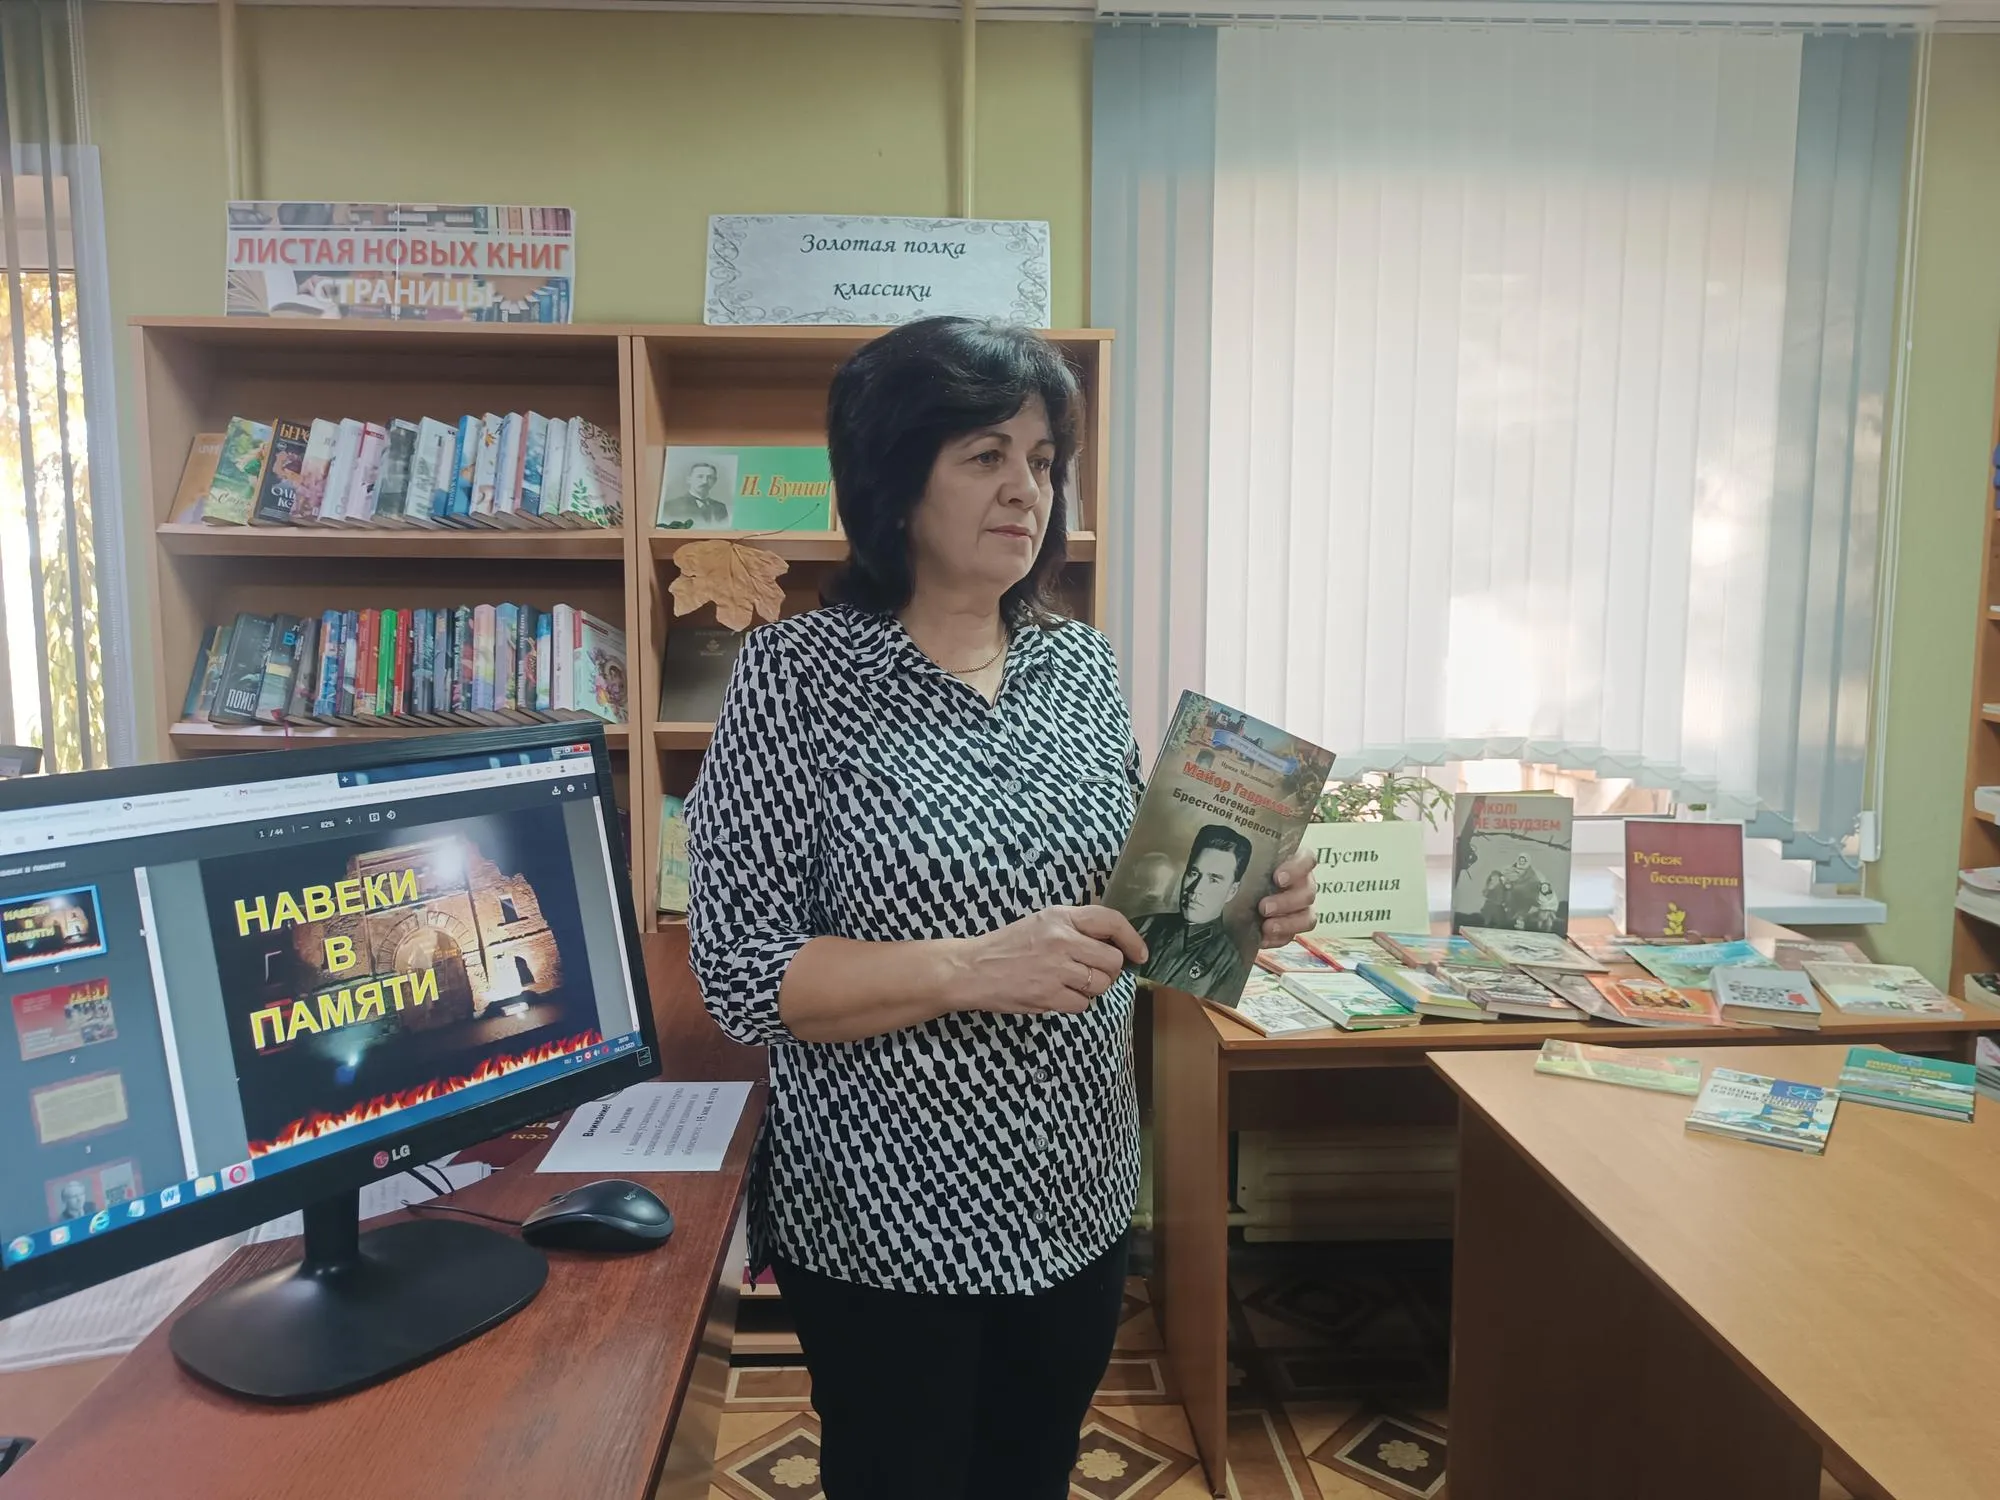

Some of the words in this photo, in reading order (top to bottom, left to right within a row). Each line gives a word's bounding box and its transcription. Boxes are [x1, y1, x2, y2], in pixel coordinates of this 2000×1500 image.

[234, 237, 354, 265] ЛИСТАЯ
[362, 239, 479, 268] НОВЫХ
[486, 242, 569, 271] КНИГ
[800, 234, 897, 254] Золотая
[904, 239, 967, 259] полка
[314, 276, 501, 309] СТРАНИЦЫ
[834, 281, 932, 302] классики
[741, 476, 761, 496] И.
[1183, 761, 1232, 792] Майор
[1172, 787, 1233, 820] Брестской
[1234, 815, 1283, 840] крепости
[1213, 793, 1256, 817] легенда
[1316, 847, 1379, 868] Пусть
[1633, 851, 1682, 868] Рубеж
[1650, 871, 1738, 889] бессмертия
[234, 868, 418, 937] НАВЕКИ
[324, 935, 357, 973] В
[250, 968, 439, 1049] ПАМЯТИ
[391, 1144, 411, 1161] LG
